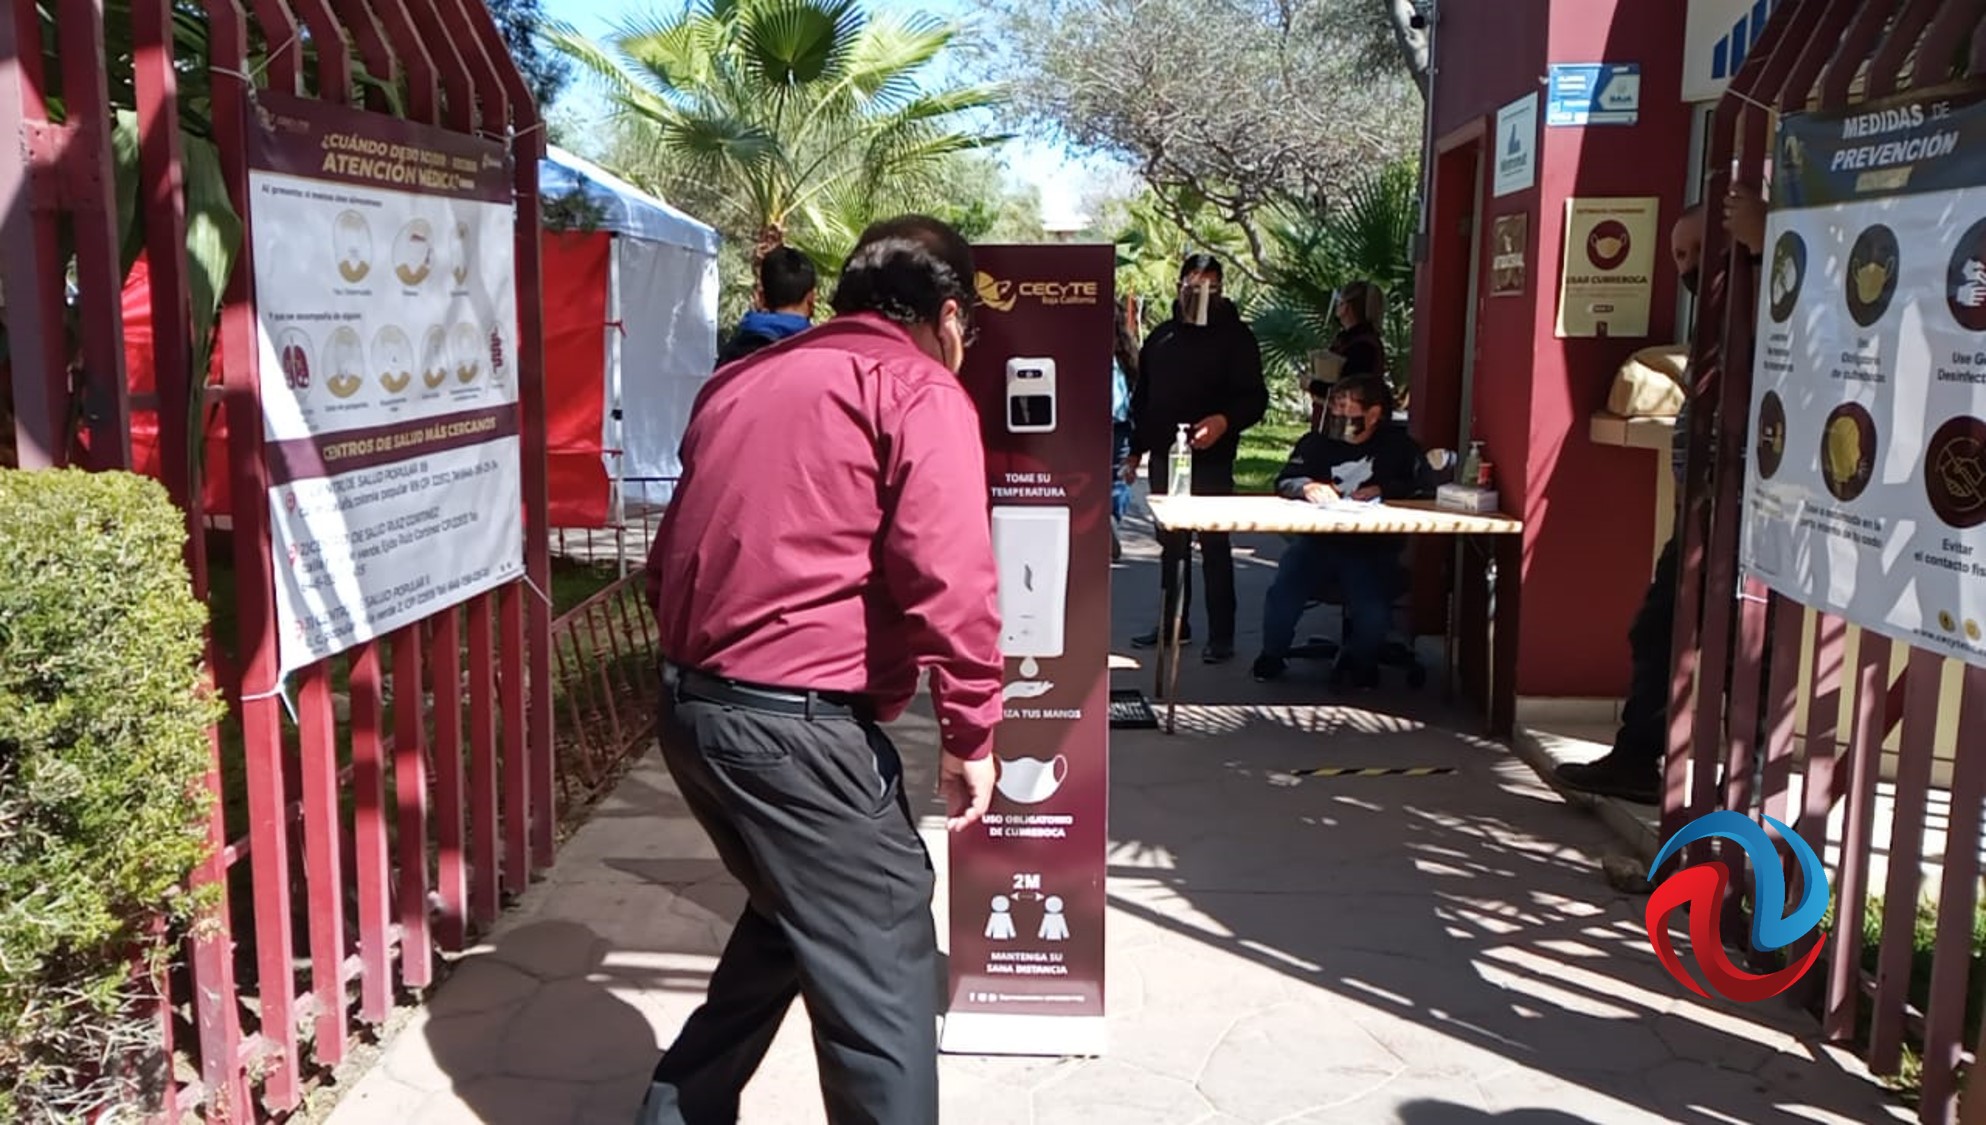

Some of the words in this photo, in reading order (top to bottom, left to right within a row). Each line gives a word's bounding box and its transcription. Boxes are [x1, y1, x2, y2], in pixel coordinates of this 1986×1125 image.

[1842, 104, 1924, 139] MEDIDAS
[1932, 101, 1950, 120] DE
[321, 133, 387, 157] ¿CUÁNDO
[1830, 129, 1959, 172] PREVENCIÓN
[322, 152, 417, 185] ATENCIÓN
[1019, 282, 1097, 297] CECYTE
[1952, 351, 1971, 364] Use
[323, 439, 373, 462] CENTROS
[376, 436, 392, 451] DE
[394, 430, 424, 448] SALUD
[425, 423, 447, 442] MÁS
[1005, 472, 1035, 483] TOME
[1037, 472, 1051, 483] SU
[991, 486, 1067, 497] TEMPERATURA
[1941, 538, 1974, 555] Evitar
[1925, 555, 1970, 573] contacto
[1003, 708, 1020, 719] IZA
[1021, 708, 1041, 719] TUS
[1042, 708, 1081, 719] MANOS
[982, 814, 1003, 824] USO
[989, 827, 1003, 837] DE
[1013, 874, 1041, 889] 2M
[991, 952, 1047, 962] MANTENGA
[1049, 953, 1064, 962] SU
[986, 963, 1014, 973] SANA
[1015, 964, 1068, 975] DISTANCIA
